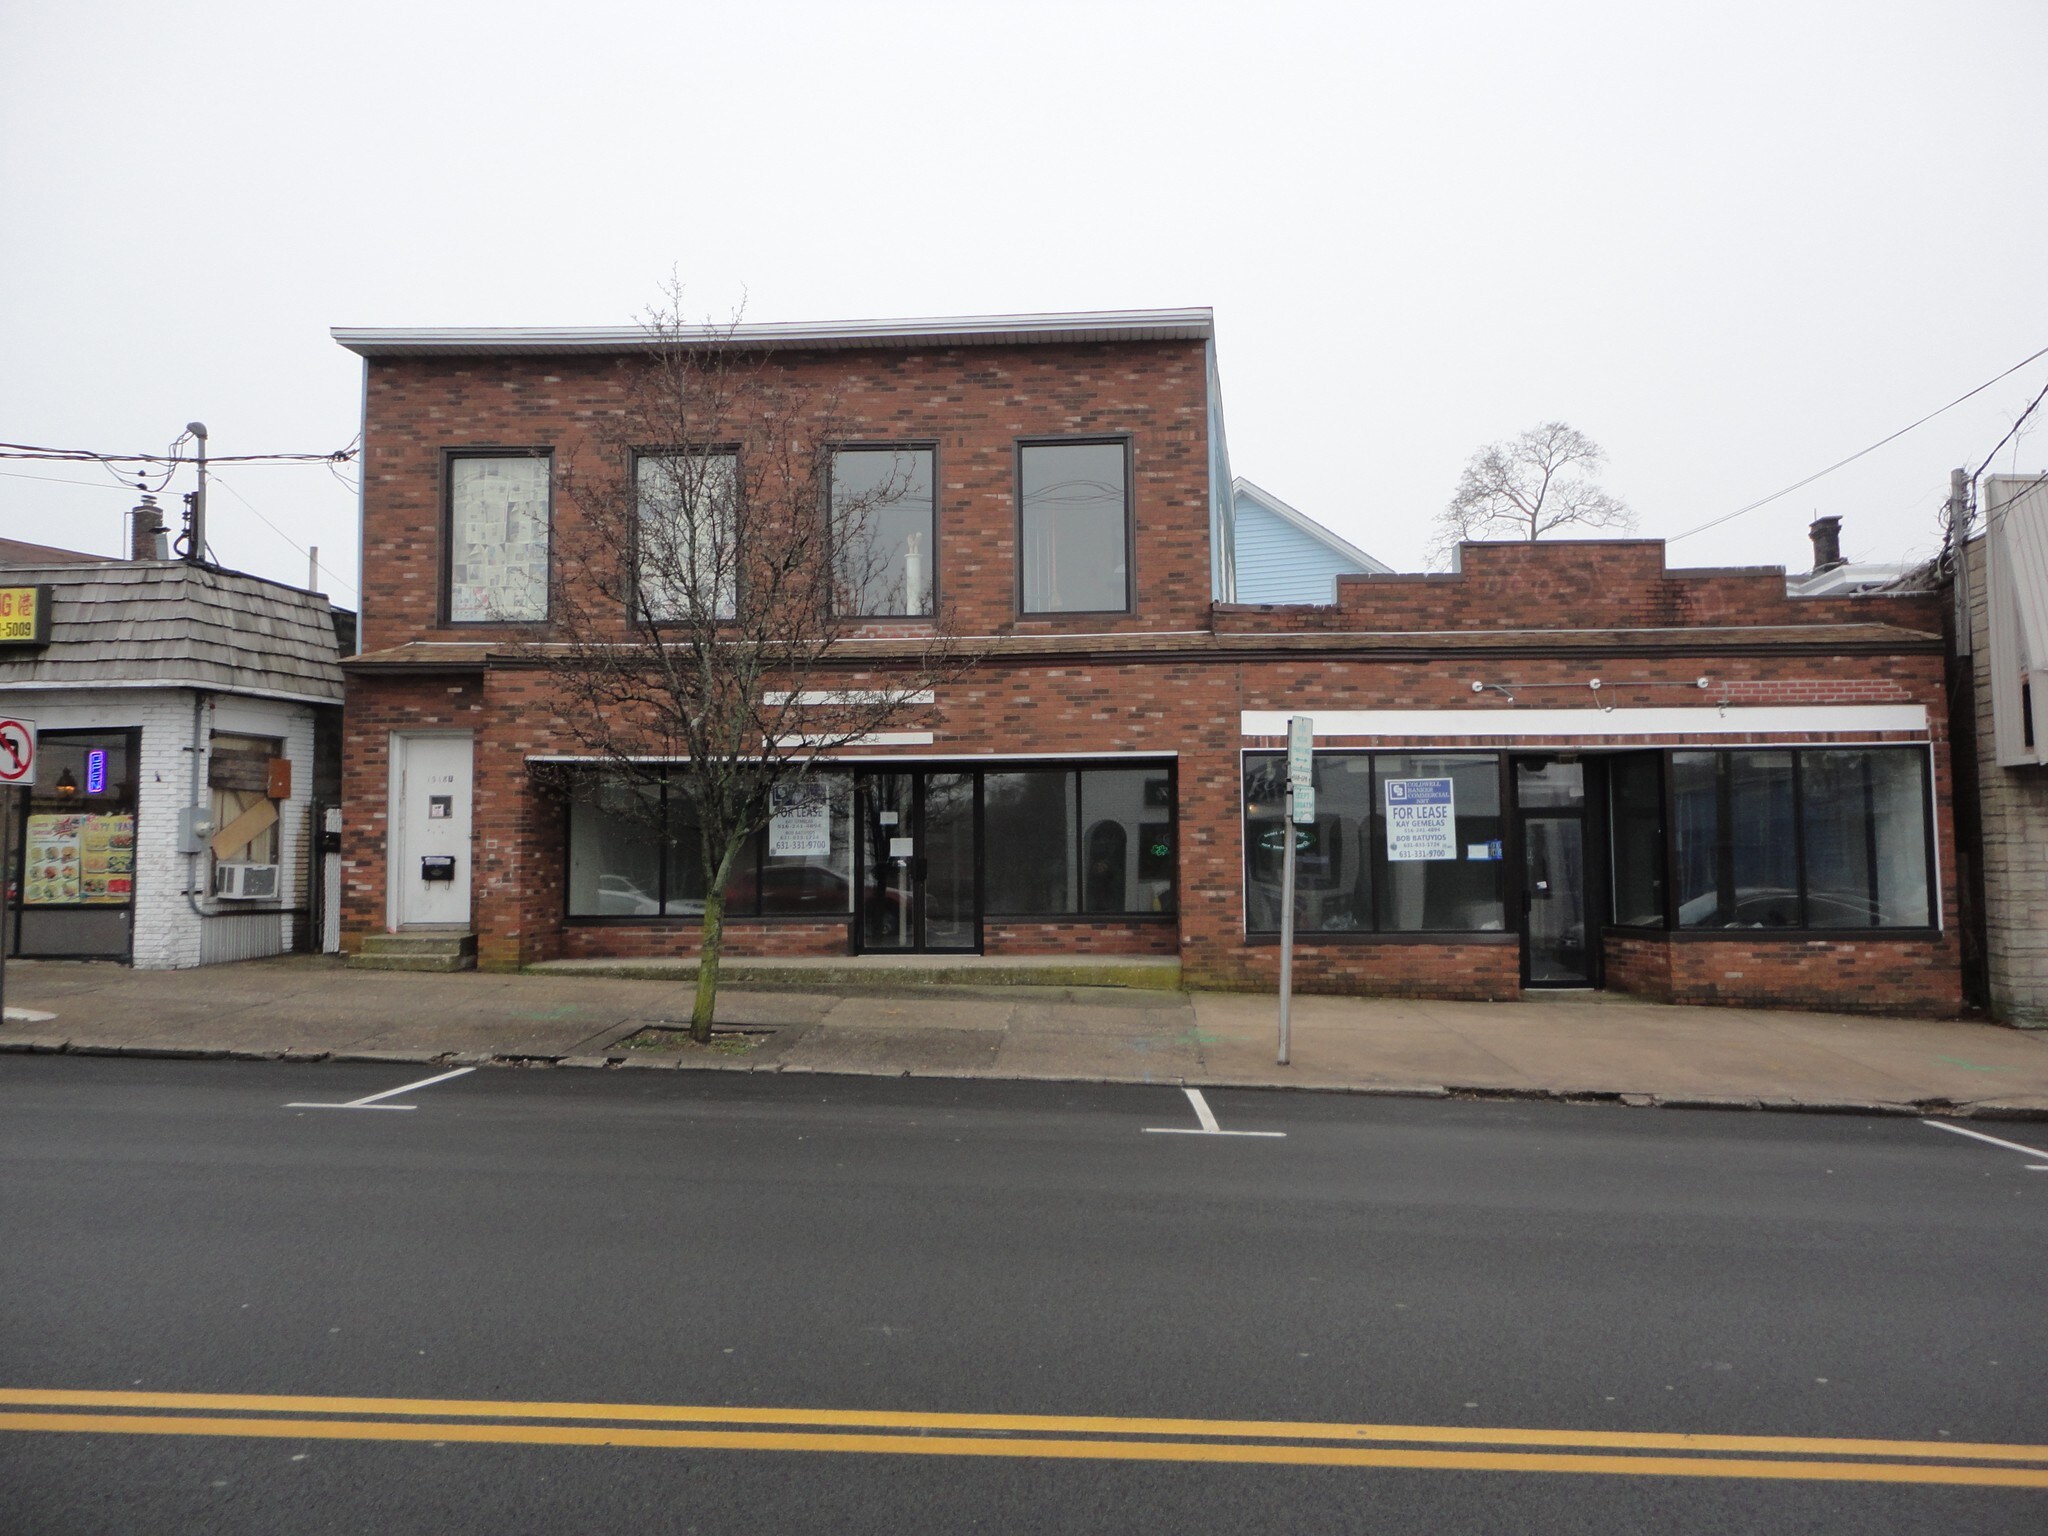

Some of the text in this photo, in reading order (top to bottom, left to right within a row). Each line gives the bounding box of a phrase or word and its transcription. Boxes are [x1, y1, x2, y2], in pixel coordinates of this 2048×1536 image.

[0, 621, 31, 637] -5009
[1393, 806, 1448, 819] FOR LEASE
[776, 841, 826, 850] 631-331-9700
[1399, 849, 1446, 858] 631-331-9700
